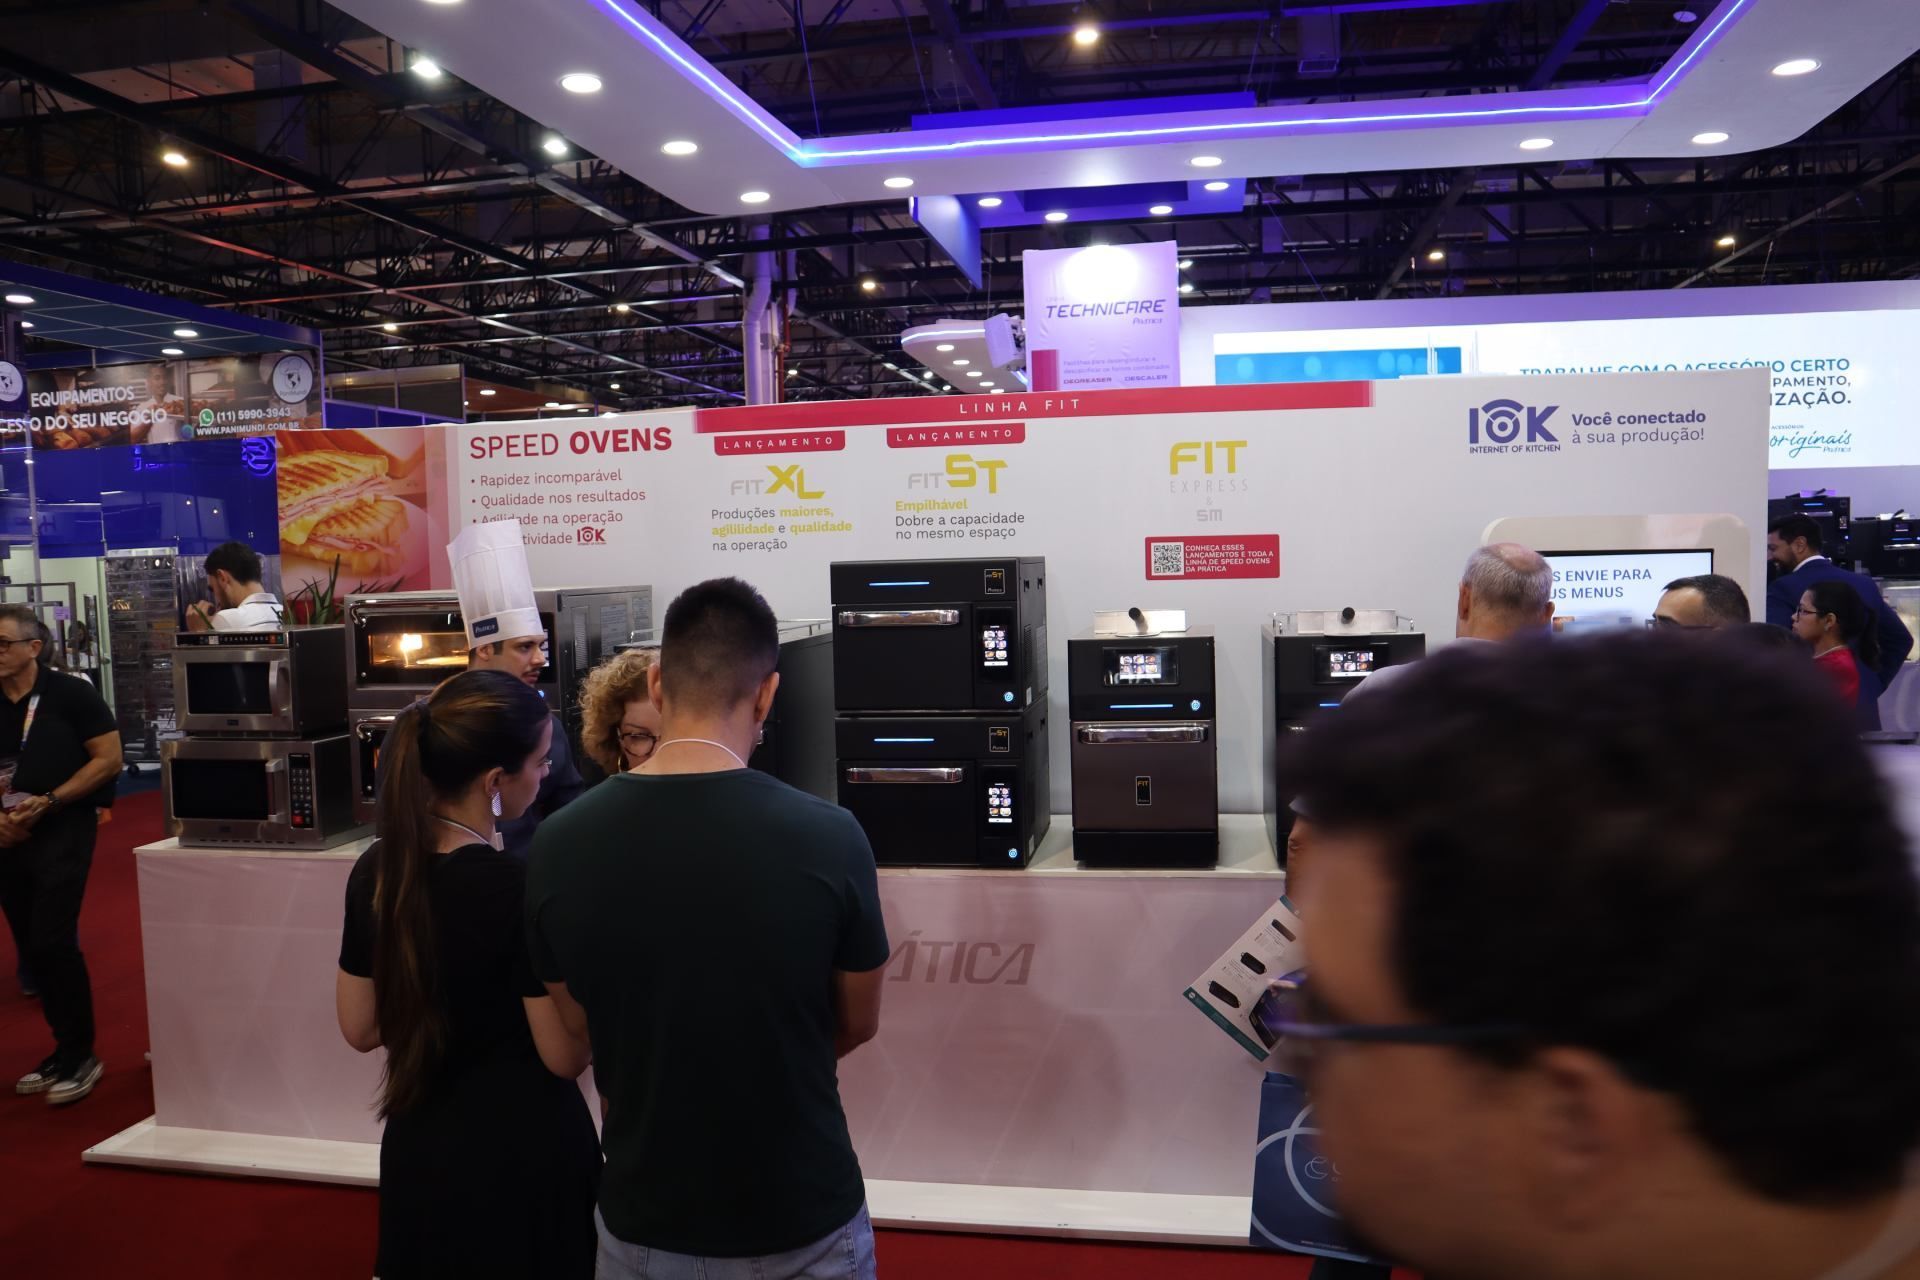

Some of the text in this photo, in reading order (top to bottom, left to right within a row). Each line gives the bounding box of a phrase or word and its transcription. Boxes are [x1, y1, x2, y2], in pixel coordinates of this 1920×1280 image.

[1046, 299, 1167, 318] TECHNICARE
[1791, 358, 1850, 372] CERTO
[1773, 375, 1851, 387] PAMENTO,
[31, 386, 135, 407] EQUIPAMENTOS
[1769, 388, 1851, 409] IZAÇÃO.
[960, 398, 1079, 414] LINHA FIT
[45, 415, 68, 430] DO
[72, 412, 97, 429] SEU
[100, 407, 167, 426] NEGÓCIO
[217, 411, 235, 423] (11)
[1571, 409, 1706, 426] Você conectado
[470, 427, 672, 459] SPEED OVENS
[723, 437, 833, 449] LANÇAMENTO
[896, 429, 1013, 442] LANÇAMENTO
[1572, 427, 1704, 446] à sua produção!
[1470, 443, 1561, 454] INTERNET OF KITCHEN
[1769, 429, 1852, 458] originais
[1170, 440, 1248, 475] FIT
[480, 468, 622, 488] Rapidez incomparável
[1170, 478, 1248, 493] EXPRESS
[481, 489, 646, 509] Qualidade nos resultados
[896, 498, 968, 513] Empilhável
[543, 513, 558, 524] na
[563, 510, 623, 526] operação
[711, 506, 834, 521] Produções maiores,
[896, 512, 1025, 527] Dobre a capacidade
[778, 525, 786, 534] e
[790, 521, 852, 535] qualidade
[896, 527, 1016, 540] no mesmo espaço
[522, 532, 573, 545] tividade
[713, 538, 788, 553] na operação
[1185, 544, 1220, 552] CONHEÇA
[1186, 551, 1240, 559] LANÇAMENTOS
[1566, 569, 1609, 581] ENVIE
[1613, 568, 1652, 580] PARA
[1572, 586, 1624, 599] MENUS
[884, 929, 1036, 985] ÁTICA
